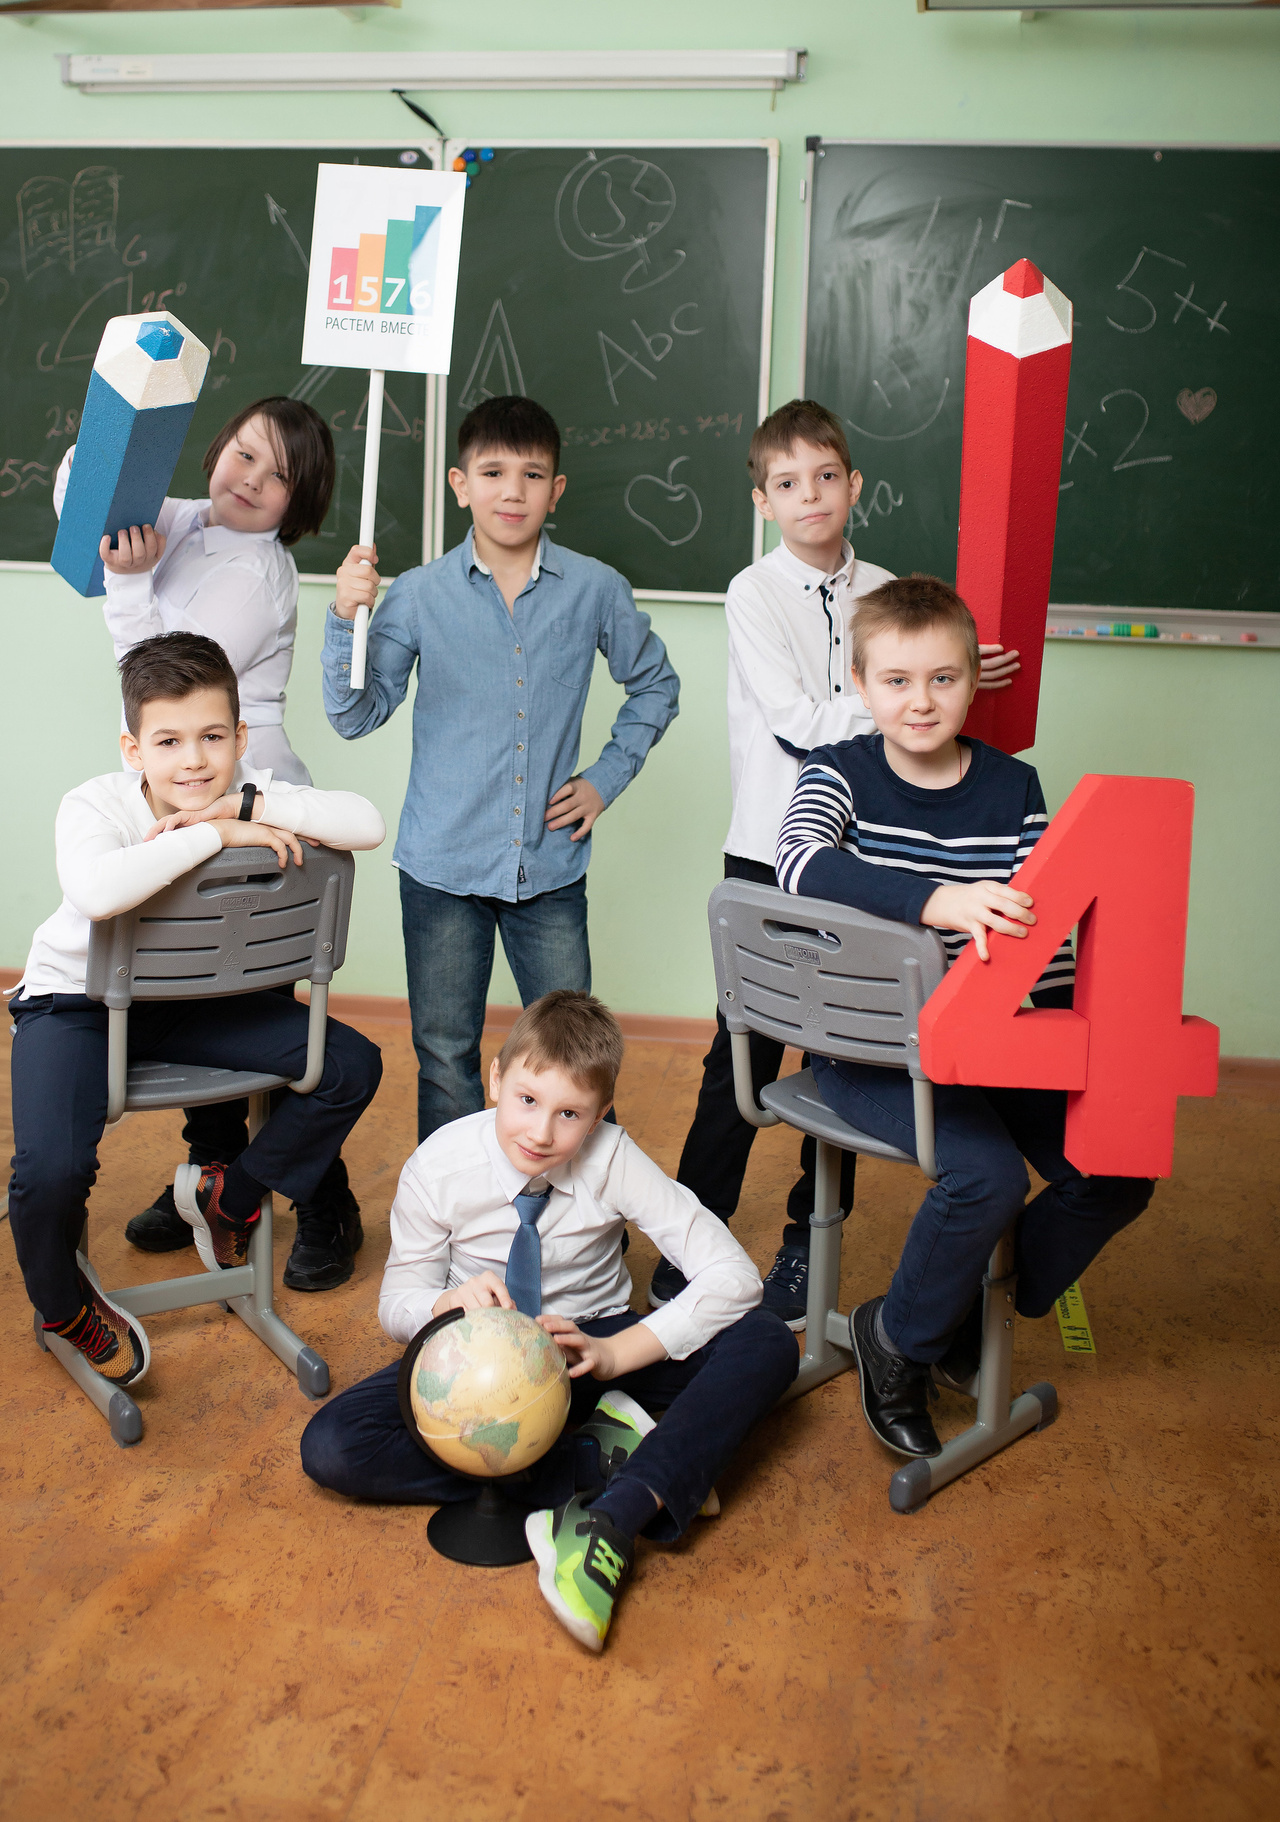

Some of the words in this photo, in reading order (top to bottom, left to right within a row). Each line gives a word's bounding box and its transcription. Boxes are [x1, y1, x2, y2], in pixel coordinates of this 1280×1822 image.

[332, 274, 432, 310] 1576
[325, 316, 374, 332] РАСТЕМ
[918, 774, 1220, 1179] 4
